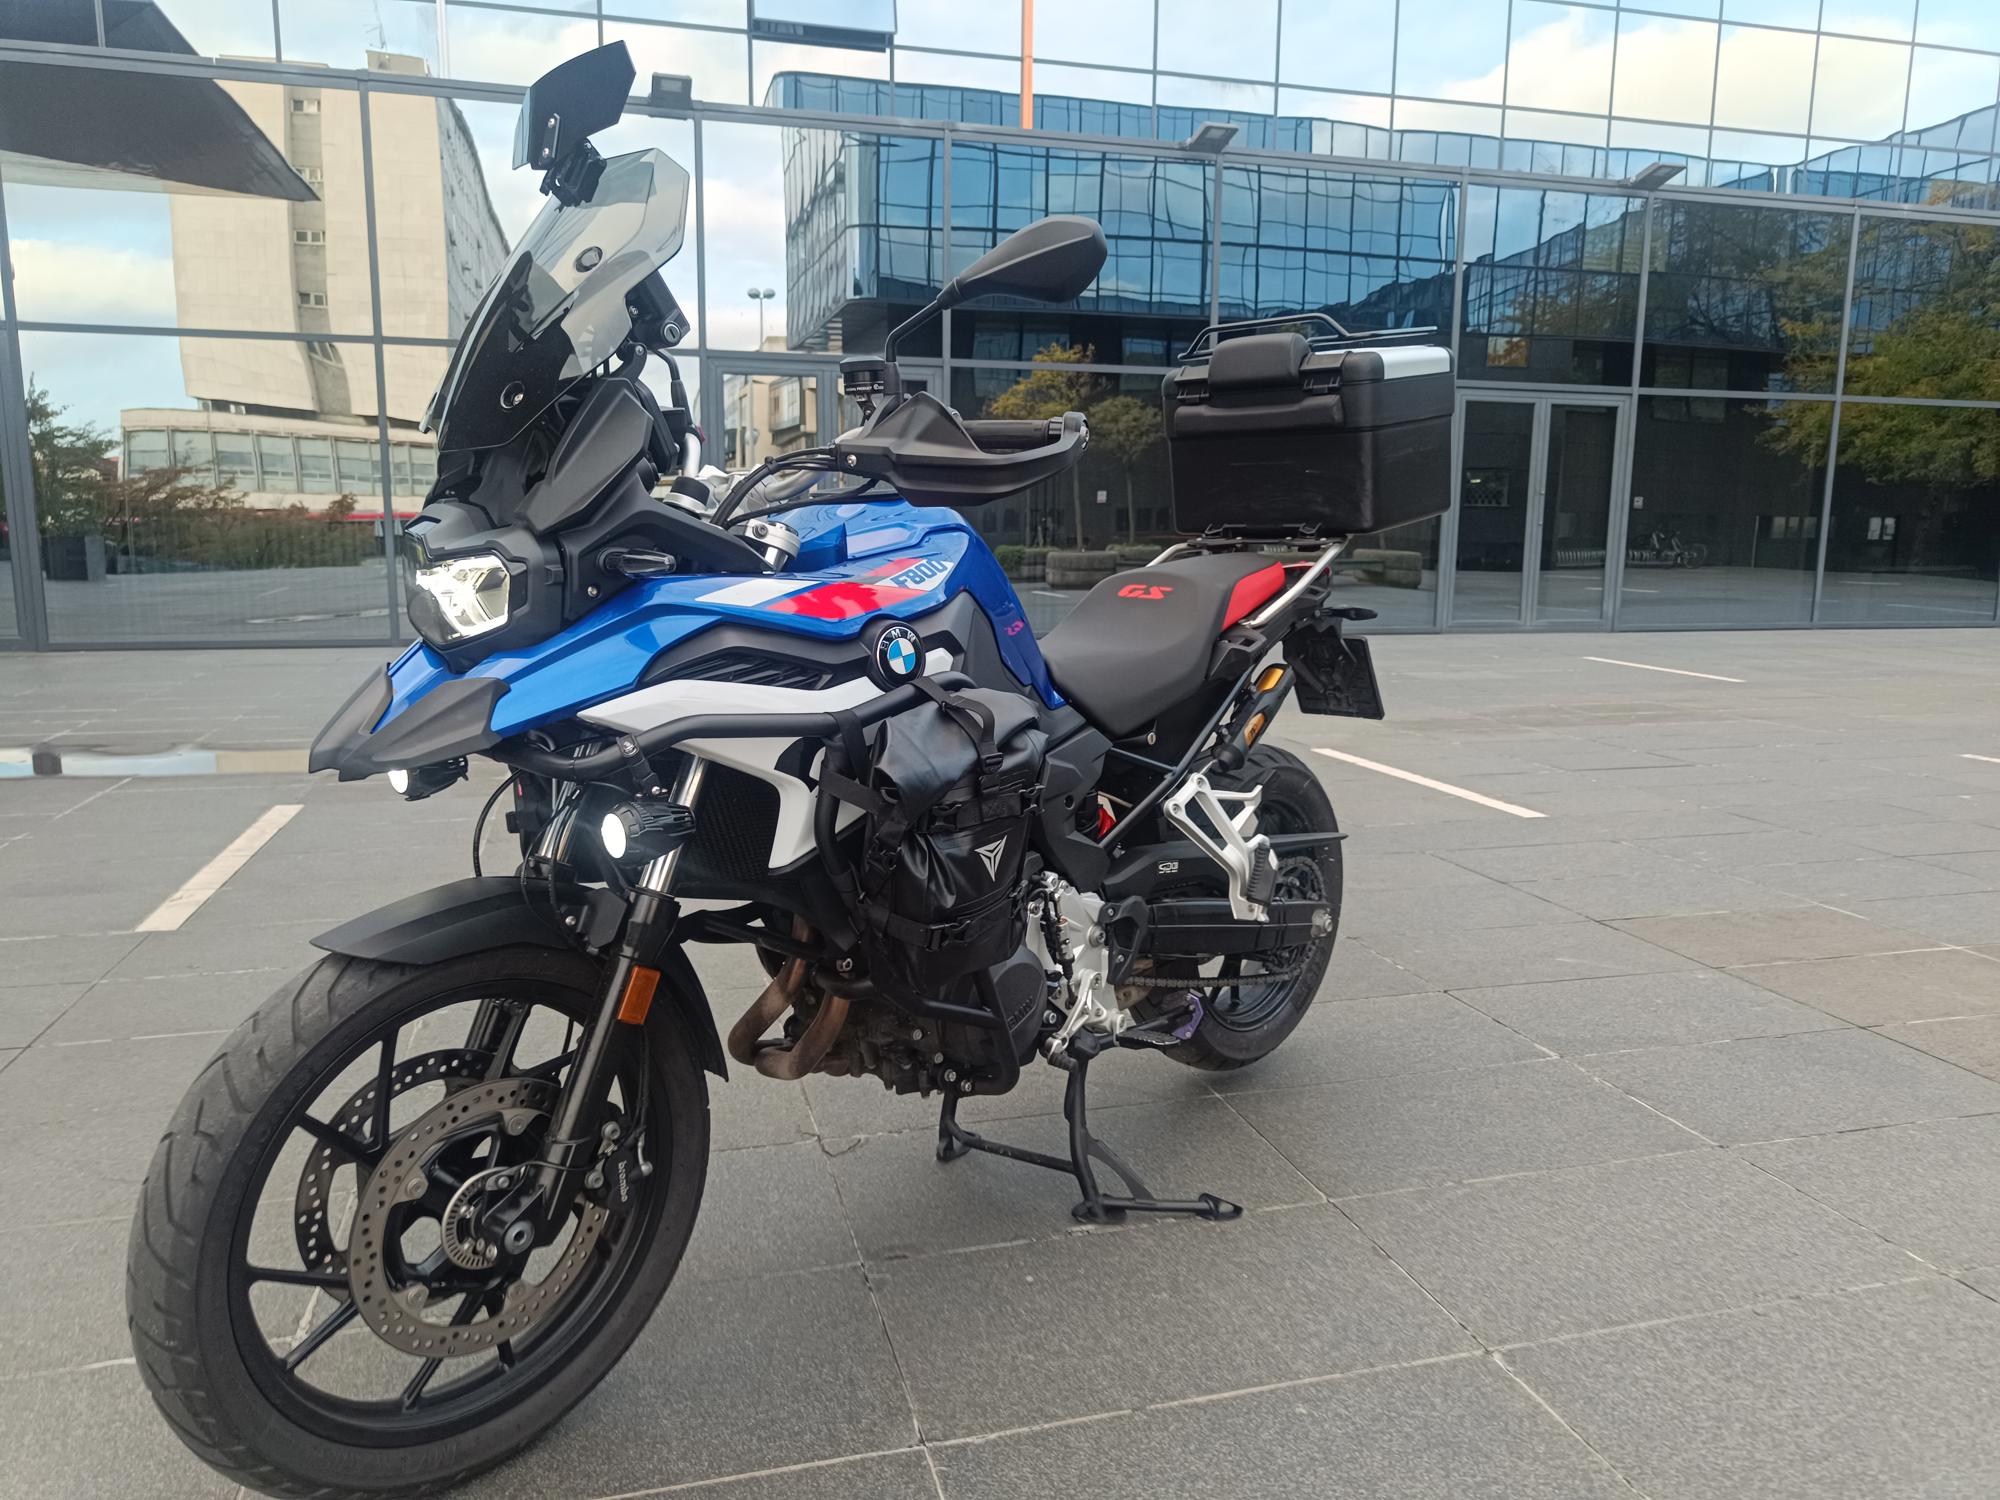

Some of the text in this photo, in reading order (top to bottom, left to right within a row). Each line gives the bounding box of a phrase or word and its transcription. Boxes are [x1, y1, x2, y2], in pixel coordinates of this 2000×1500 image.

[890, 561, 947, 587] F800
[1118, 583, 1174, 600] GS
[880, 628, 917, 651] BMW
[618, 1160, 630, 1203] brembo
